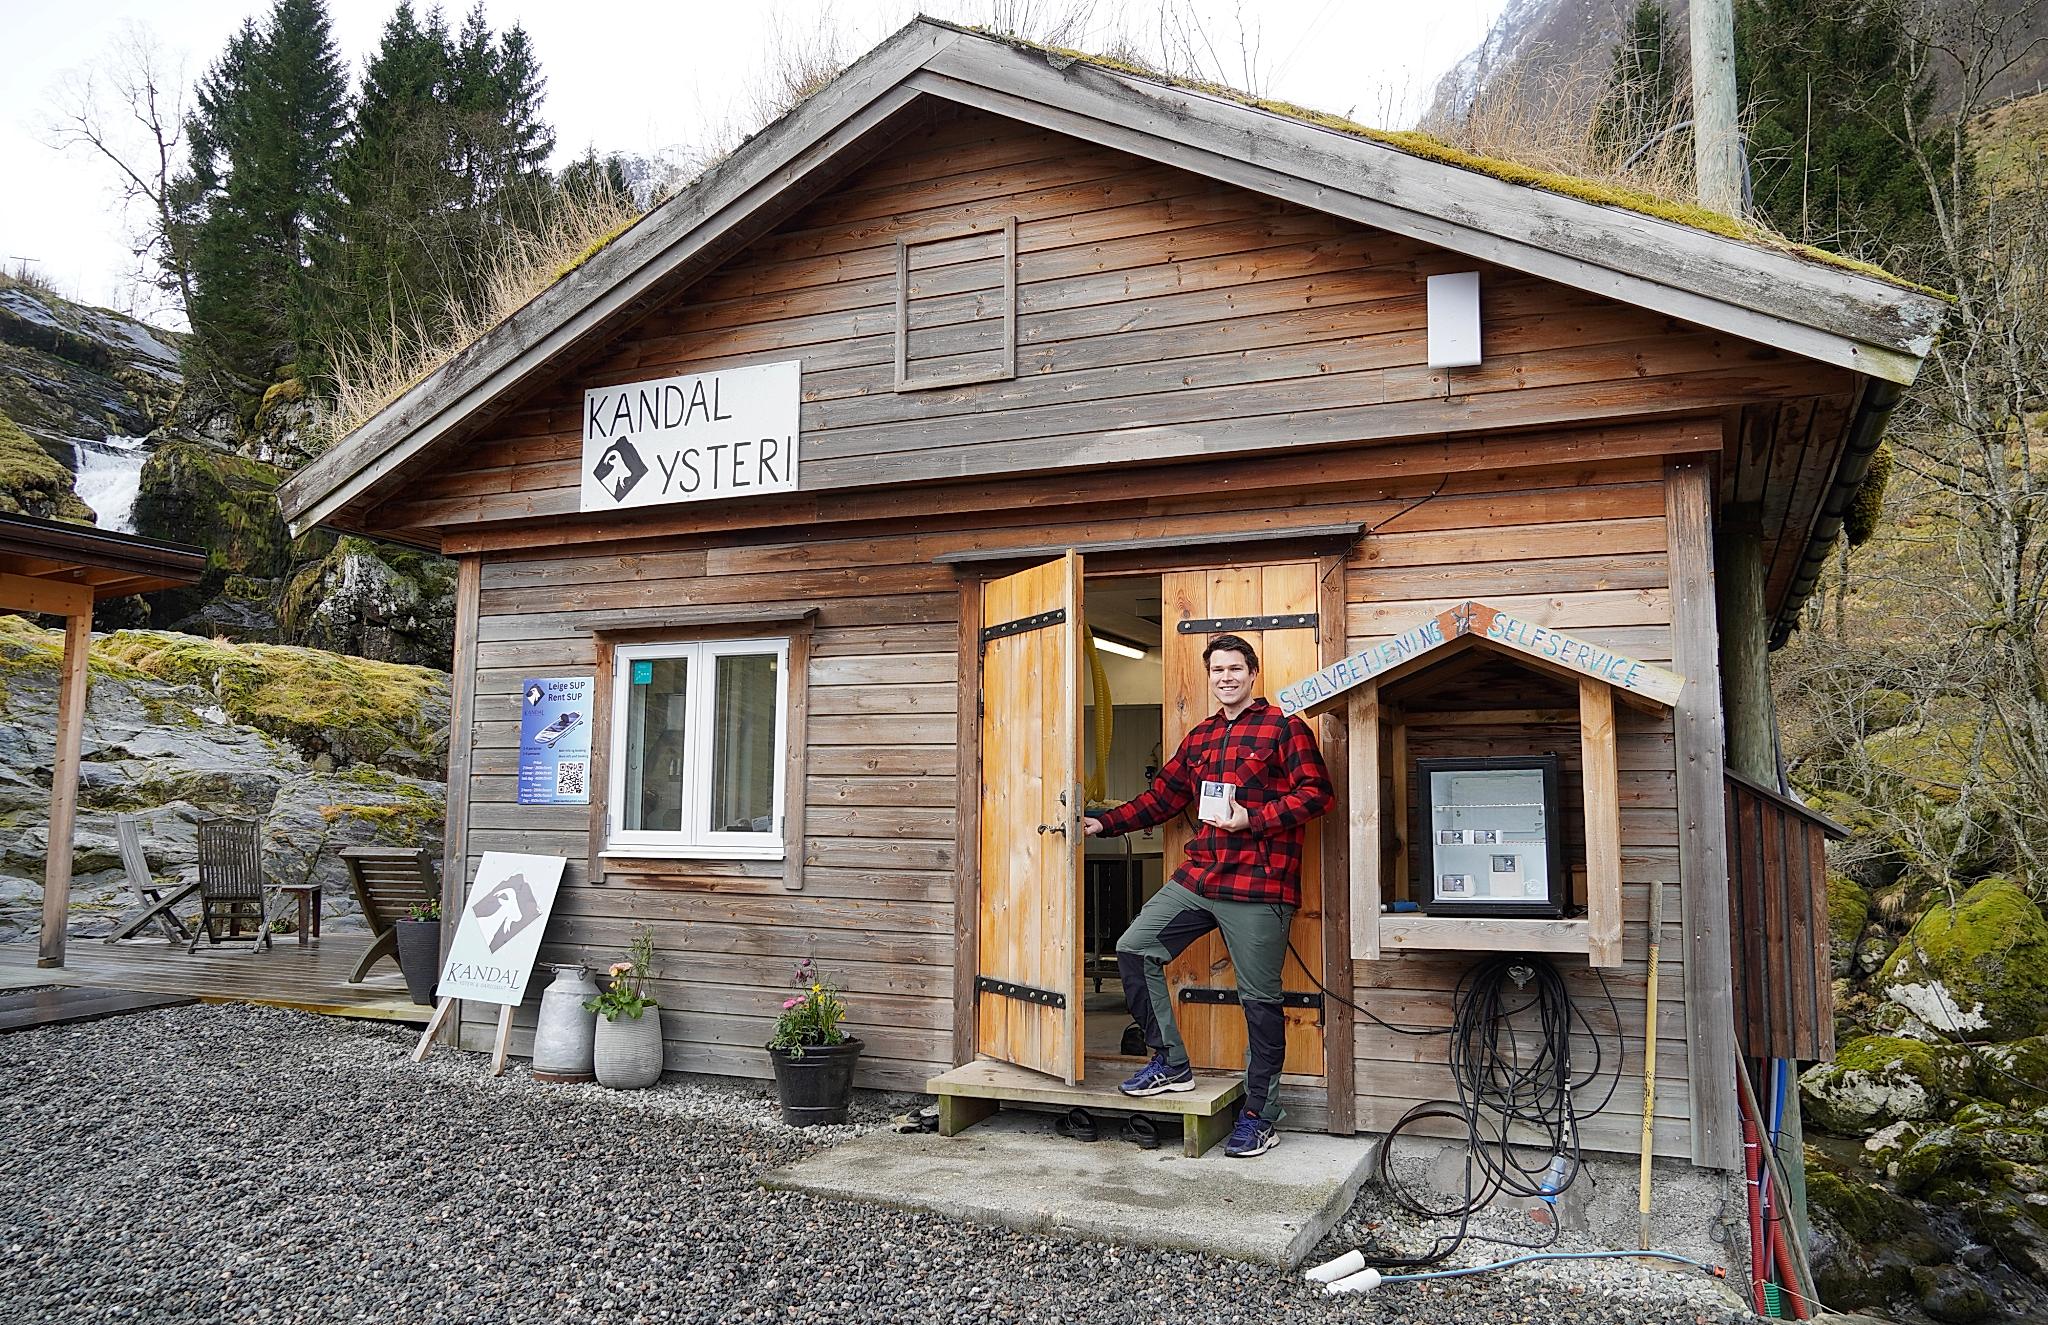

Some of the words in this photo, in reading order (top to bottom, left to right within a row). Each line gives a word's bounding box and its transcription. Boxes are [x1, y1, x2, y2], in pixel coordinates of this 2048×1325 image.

[589, 377, 732, 440] KANDAL
[656, 435, 792, 495] YSTERI
[548, 682, 568, 692] Leige
[569, 681, 586, 690] SUP
[1280, 619, 1443, 714] SJØLVBETJENING
[548, 693, 565, 702] Rent
[566, 692, 583, 701] SUP
[446, 962, 520, 990] KANDAL
